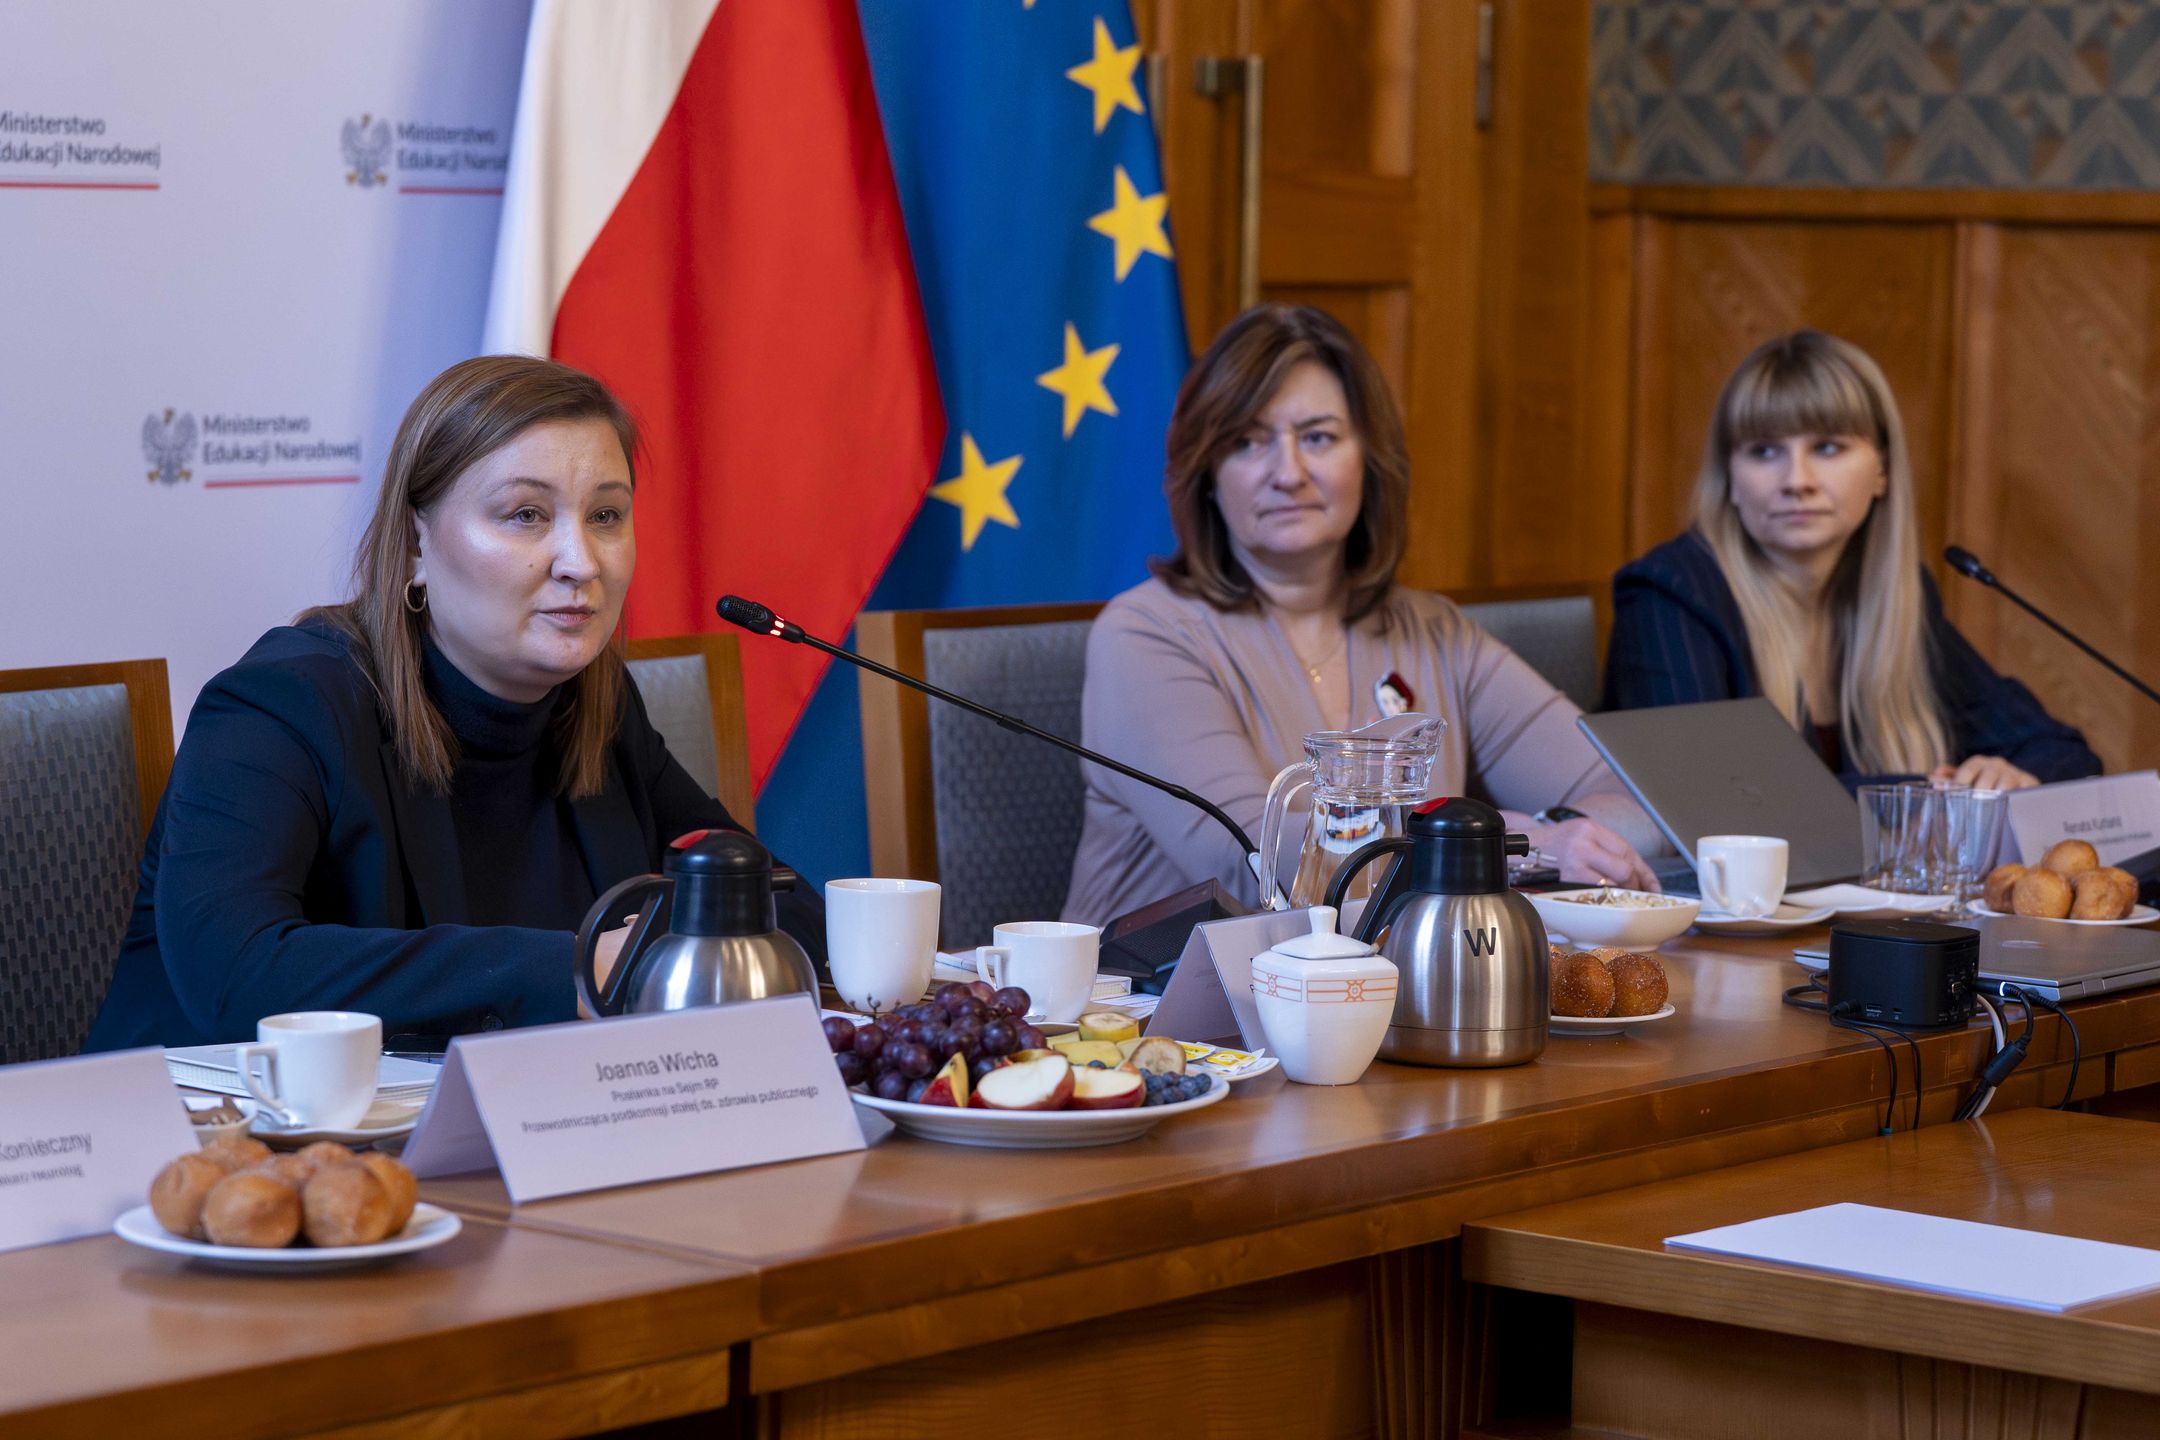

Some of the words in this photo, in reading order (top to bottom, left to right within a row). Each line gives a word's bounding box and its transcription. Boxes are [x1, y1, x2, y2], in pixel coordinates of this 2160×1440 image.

[398, 122, 496, 145] Ministerstwo
[0, 141, 63, 168] dukacji
[67, 142, 160, 170] Narodowej
[398, 148, 460, 173] Edukacji
[203, 413, 311, 435] Ministerstwo
[203, 440, 270, 467] Edukacji
[275, 436, 361, 464] Narodowej
[1463, 927, 1497, 957] W
[595, 1060, 660, 1083] Joanna
[660, 1051, 719, 1073] Wicha
[661, 1085, 676, 1096] na
[676, 1080, 703, 1095] Sejm
[703, 1077, 719, 1090] RP
[718, 1093, 758, 1109] zdrowia
[758, 1086, 820, 1105] publicznego
